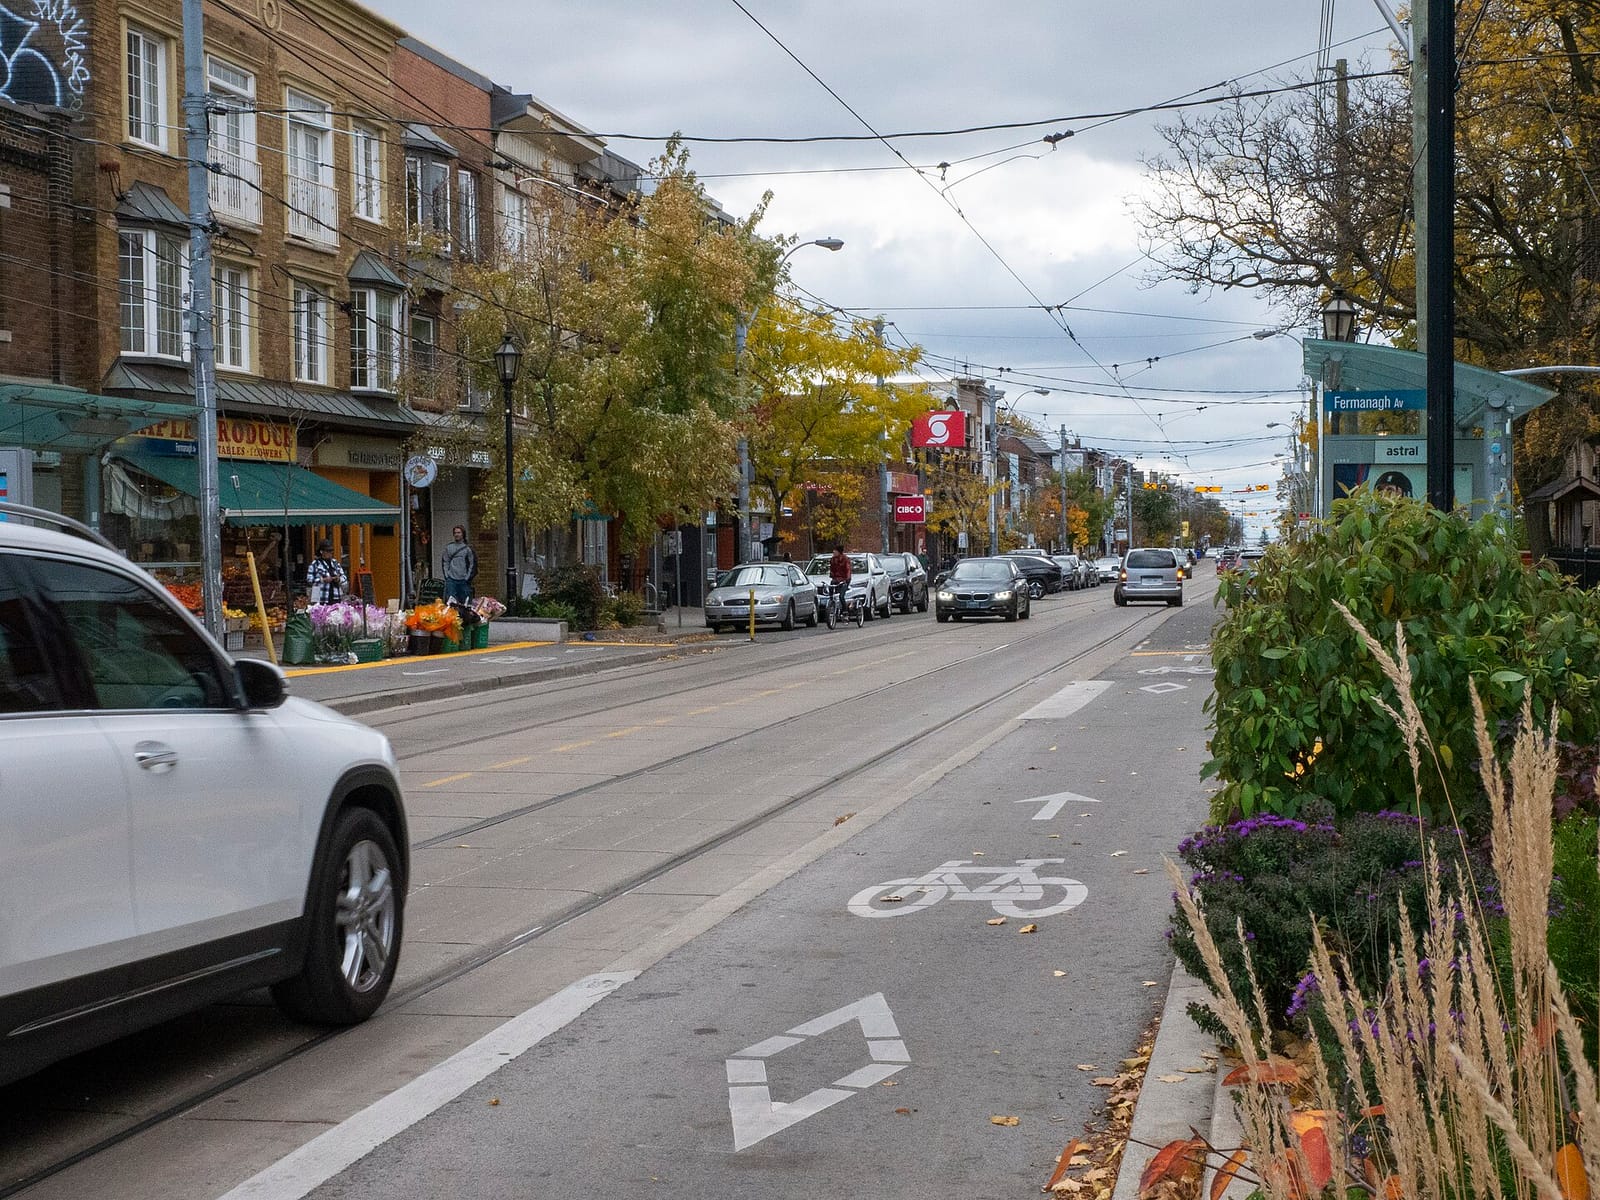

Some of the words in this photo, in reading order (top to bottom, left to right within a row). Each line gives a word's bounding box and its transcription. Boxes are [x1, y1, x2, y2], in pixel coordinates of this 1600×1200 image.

[1334, 395, 1391, 410] Fermanagh
[1394, 398, 1404, 408] Av
[217, 420, 293, 448] RODUCE
[217, 445, 246, 456] TABLES
[1386, 446, 1419, 456] astral
[897, 506, 915, 514] CIBC
